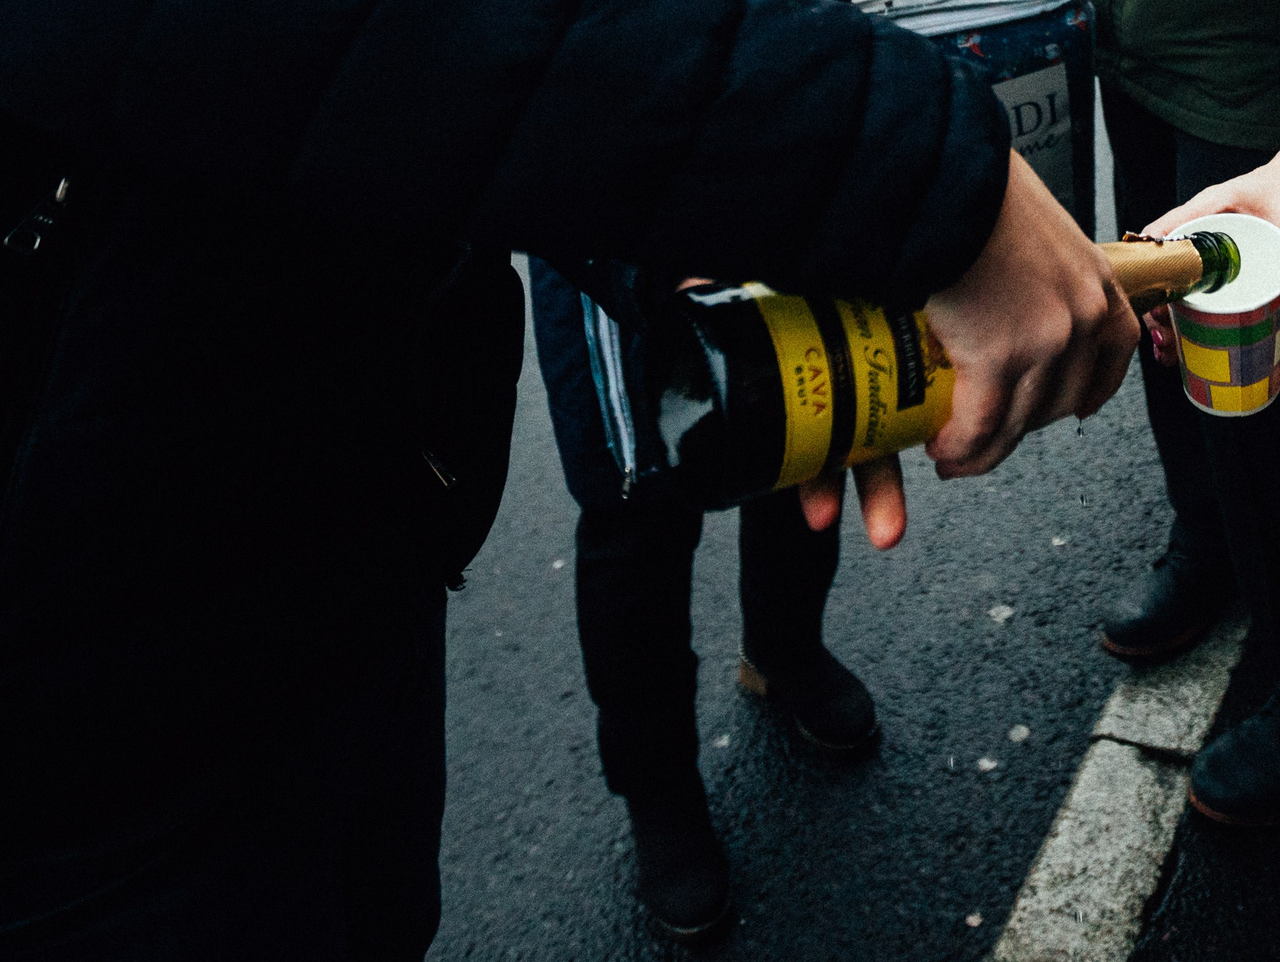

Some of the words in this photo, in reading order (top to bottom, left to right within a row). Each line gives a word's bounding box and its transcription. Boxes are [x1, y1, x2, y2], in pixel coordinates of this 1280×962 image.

[1011, 91, 1058, 137] DI
[1020, 133, 1061, 155] me
[794, 363, 808, 407] BRUT
[804, 346, 827, 417] CAVA
